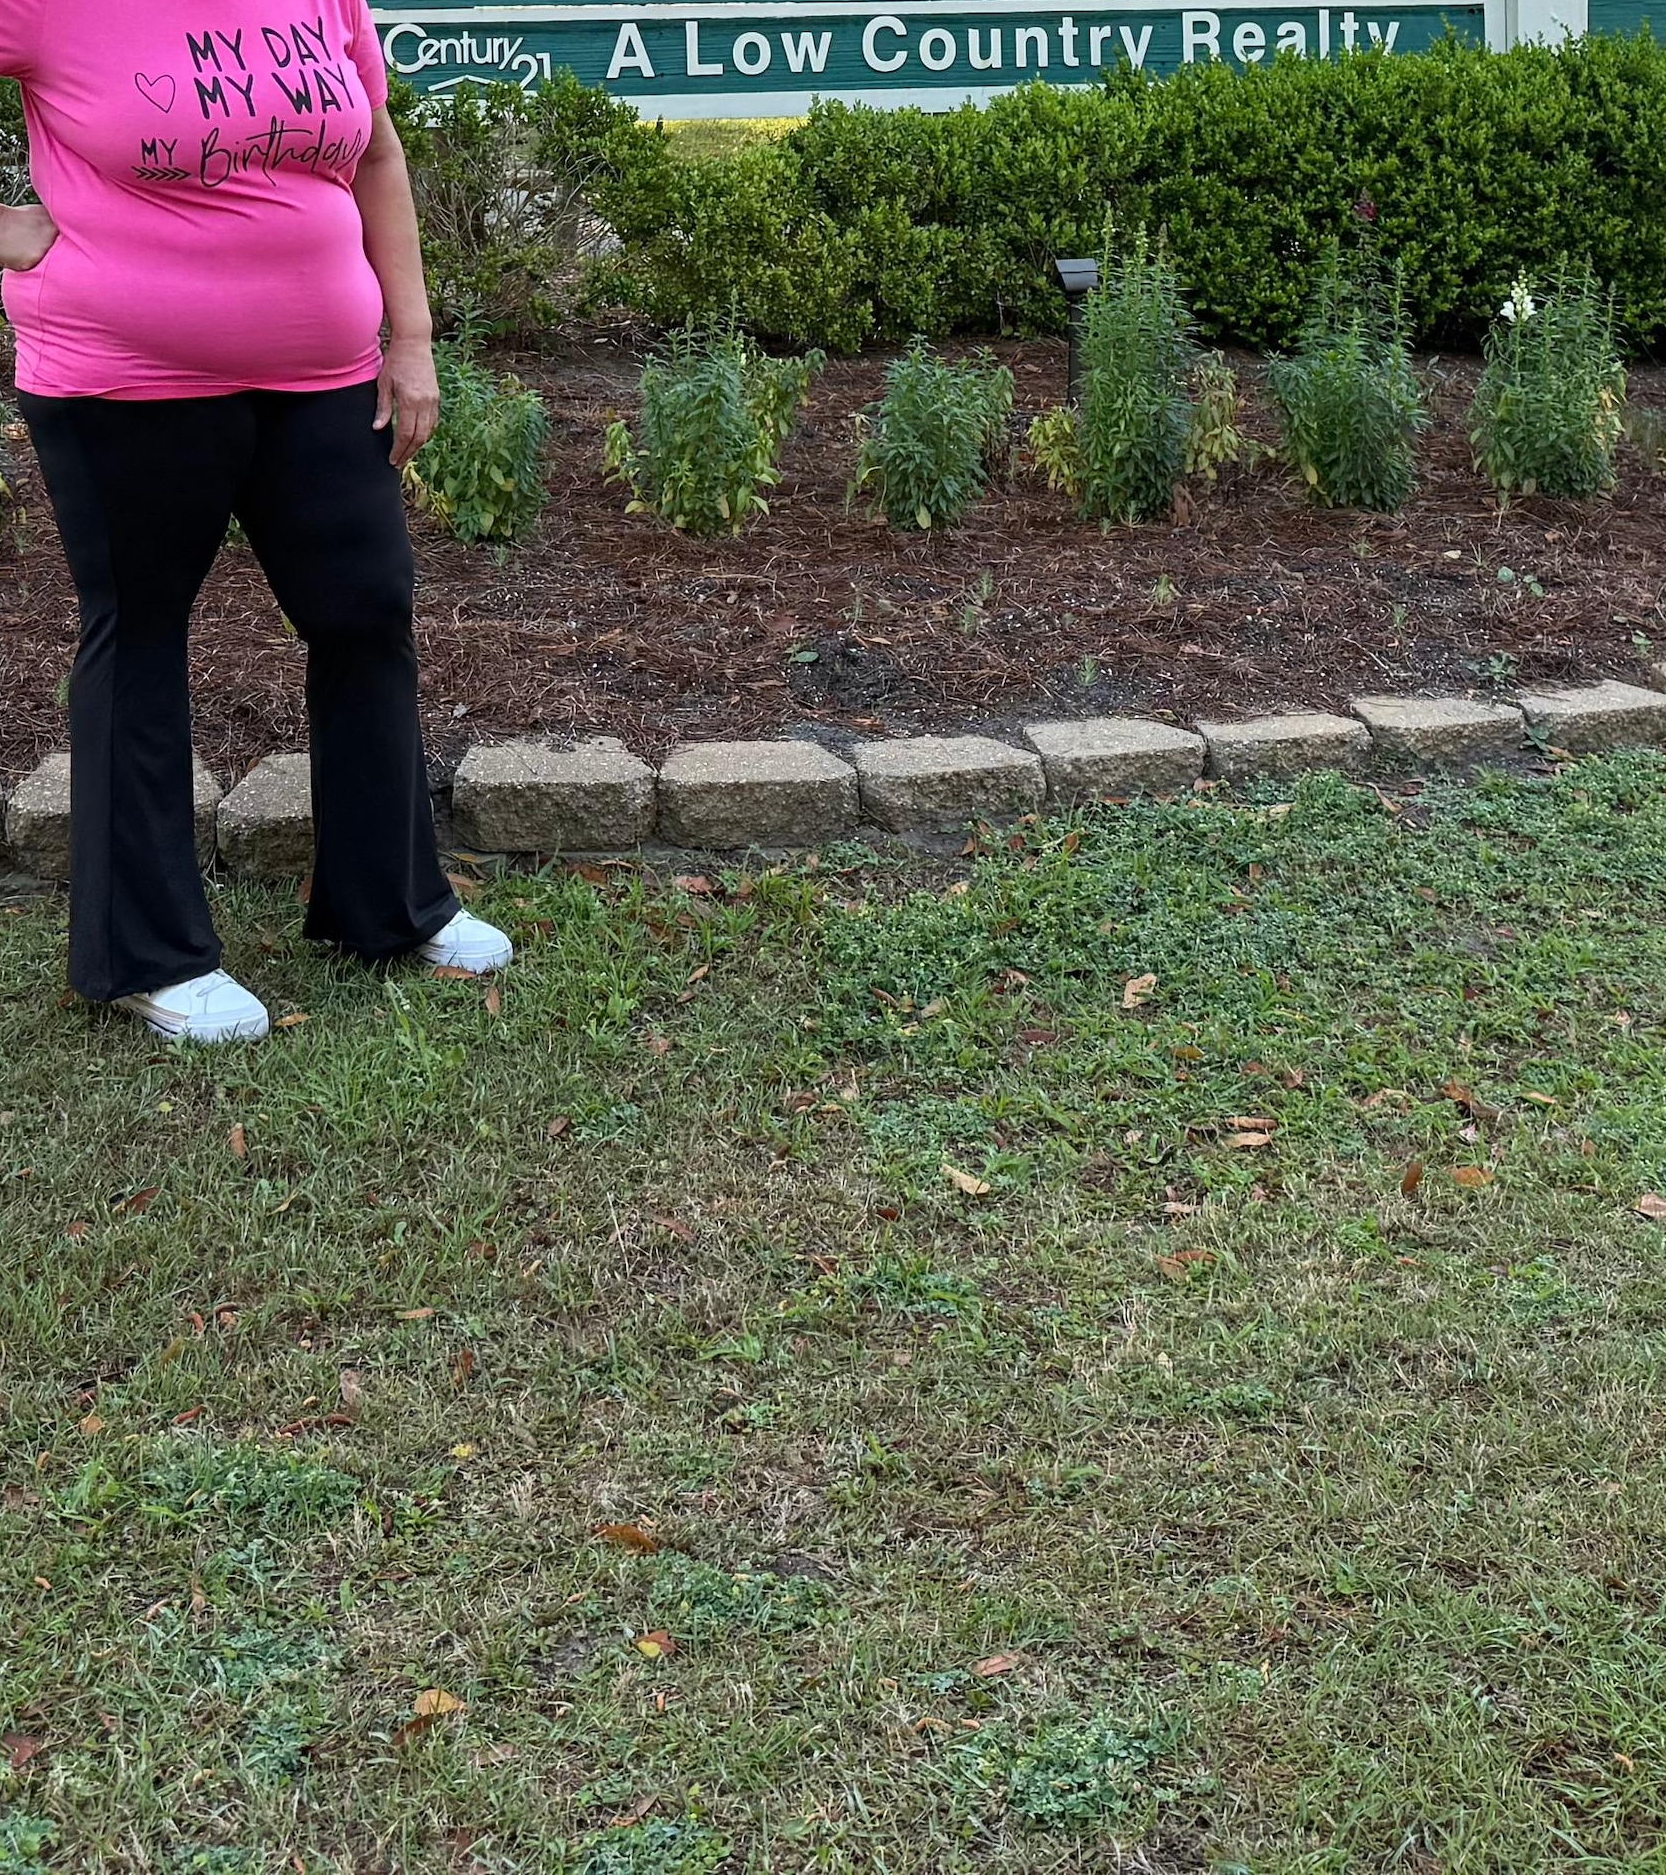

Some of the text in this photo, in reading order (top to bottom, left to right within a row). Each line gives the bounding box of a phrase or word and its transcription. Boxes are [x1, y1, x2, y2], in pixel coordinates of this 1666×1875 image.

[186, 16, 333, 73] MY DAY
[383, 23, 524, 74] Century
[511, 52, 552, 90] 21
[606, 22, 655, 79] A
[685, 19, 833, 77] Low
[862, 14, 1154, 73] Country
[193, 63, 355, 120] MY WAY
[141, 115, 365, 187] MY Birthday
